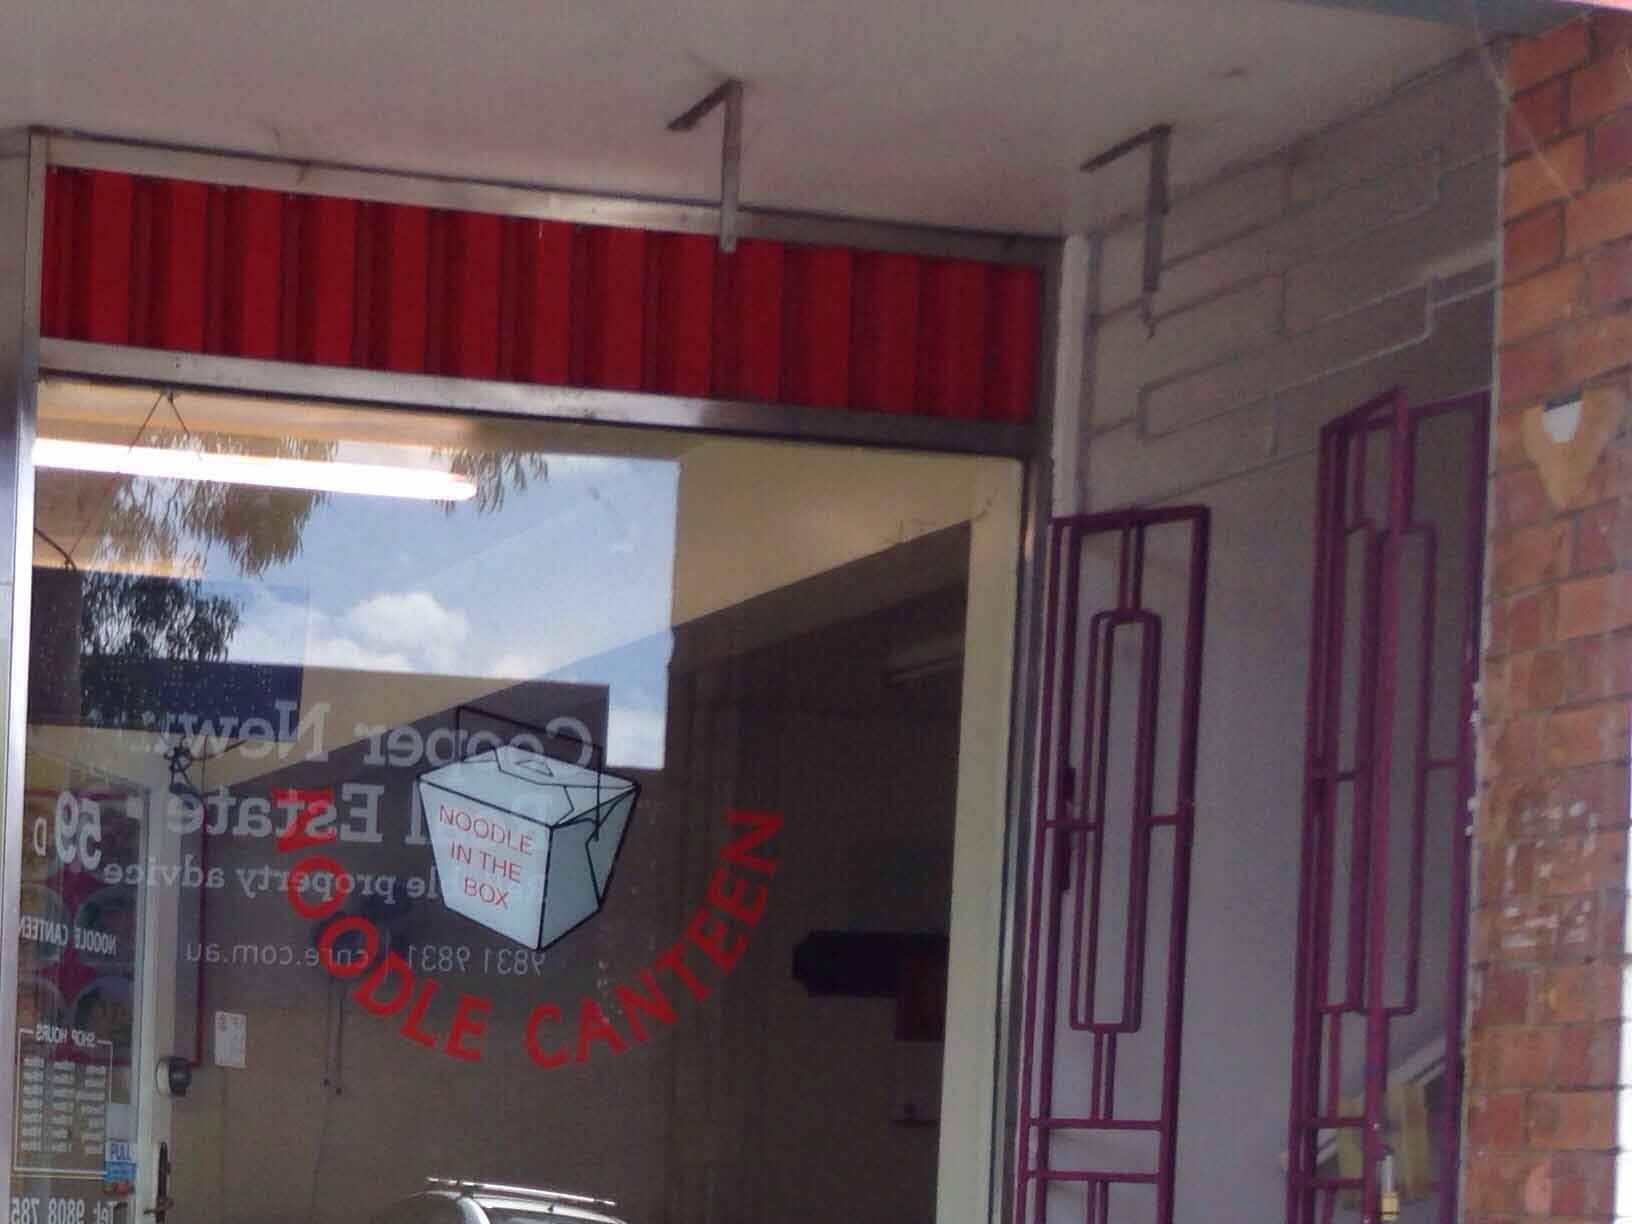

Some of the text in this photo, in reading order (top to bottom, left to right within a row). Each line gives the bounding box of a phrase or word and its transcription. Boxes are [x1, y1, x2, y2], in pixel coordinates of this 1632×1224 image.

[438, 804, 534, 857] NOODLE
[451, 841, 472, 865] IN
[480, 849, 523, 884] THE
[464, 875, 510, 911] BOX
[271, 786, 785, 1070] NOODLE CANTEEN
